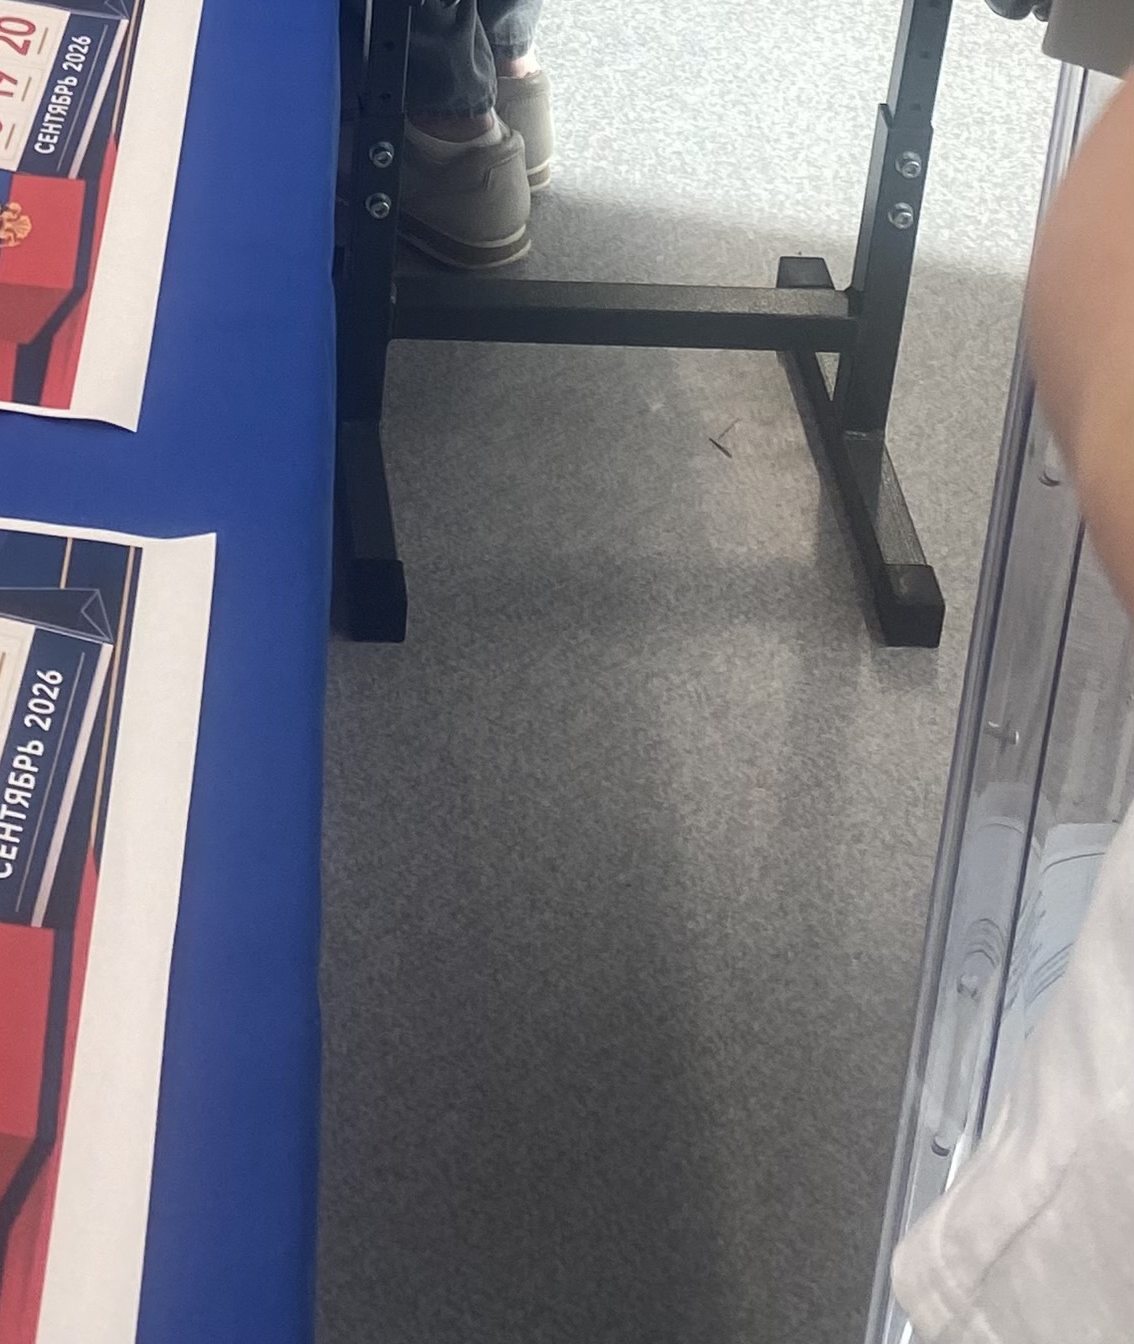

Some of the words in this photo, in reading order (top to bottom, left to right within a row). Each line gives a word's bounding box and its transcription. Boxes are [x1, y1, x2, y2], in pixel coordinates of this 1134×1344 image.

[34, 74, 78, 154] СЕНТЯБРЬ
[62, 35, 92, 72] 2026
[24, 668, 64, 732] 2026
